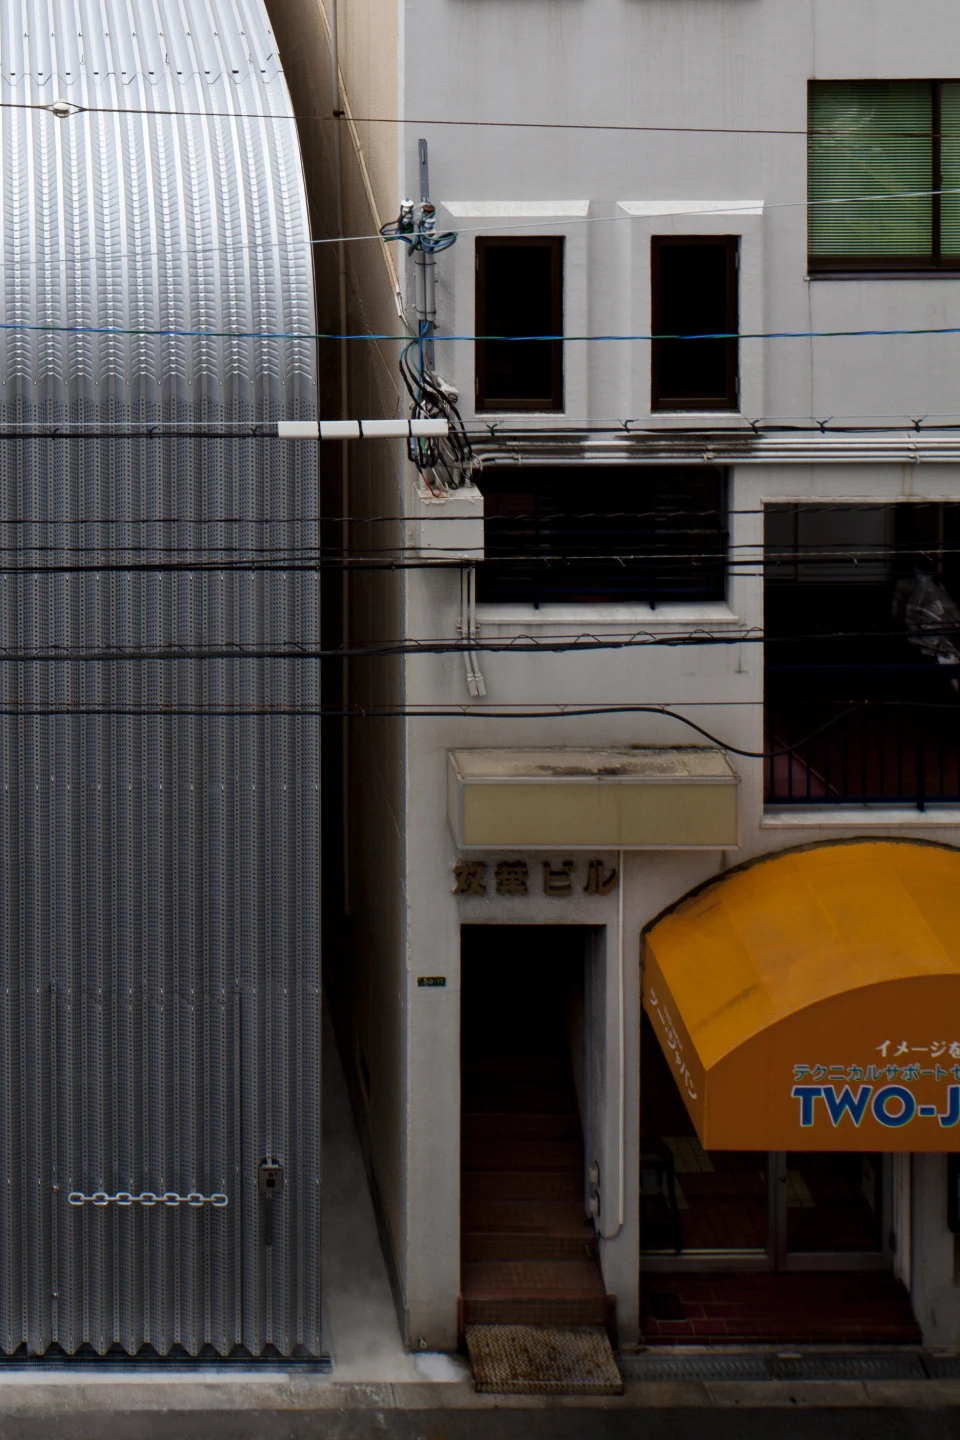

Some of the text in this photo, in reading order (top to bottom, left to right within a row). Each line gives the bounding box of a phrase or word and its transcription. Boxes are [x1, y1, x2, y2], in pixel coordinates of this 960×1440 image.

[451, 860, 618, 896] 双葉ビル
[791, 1084, 960, 1128] TWO-J
